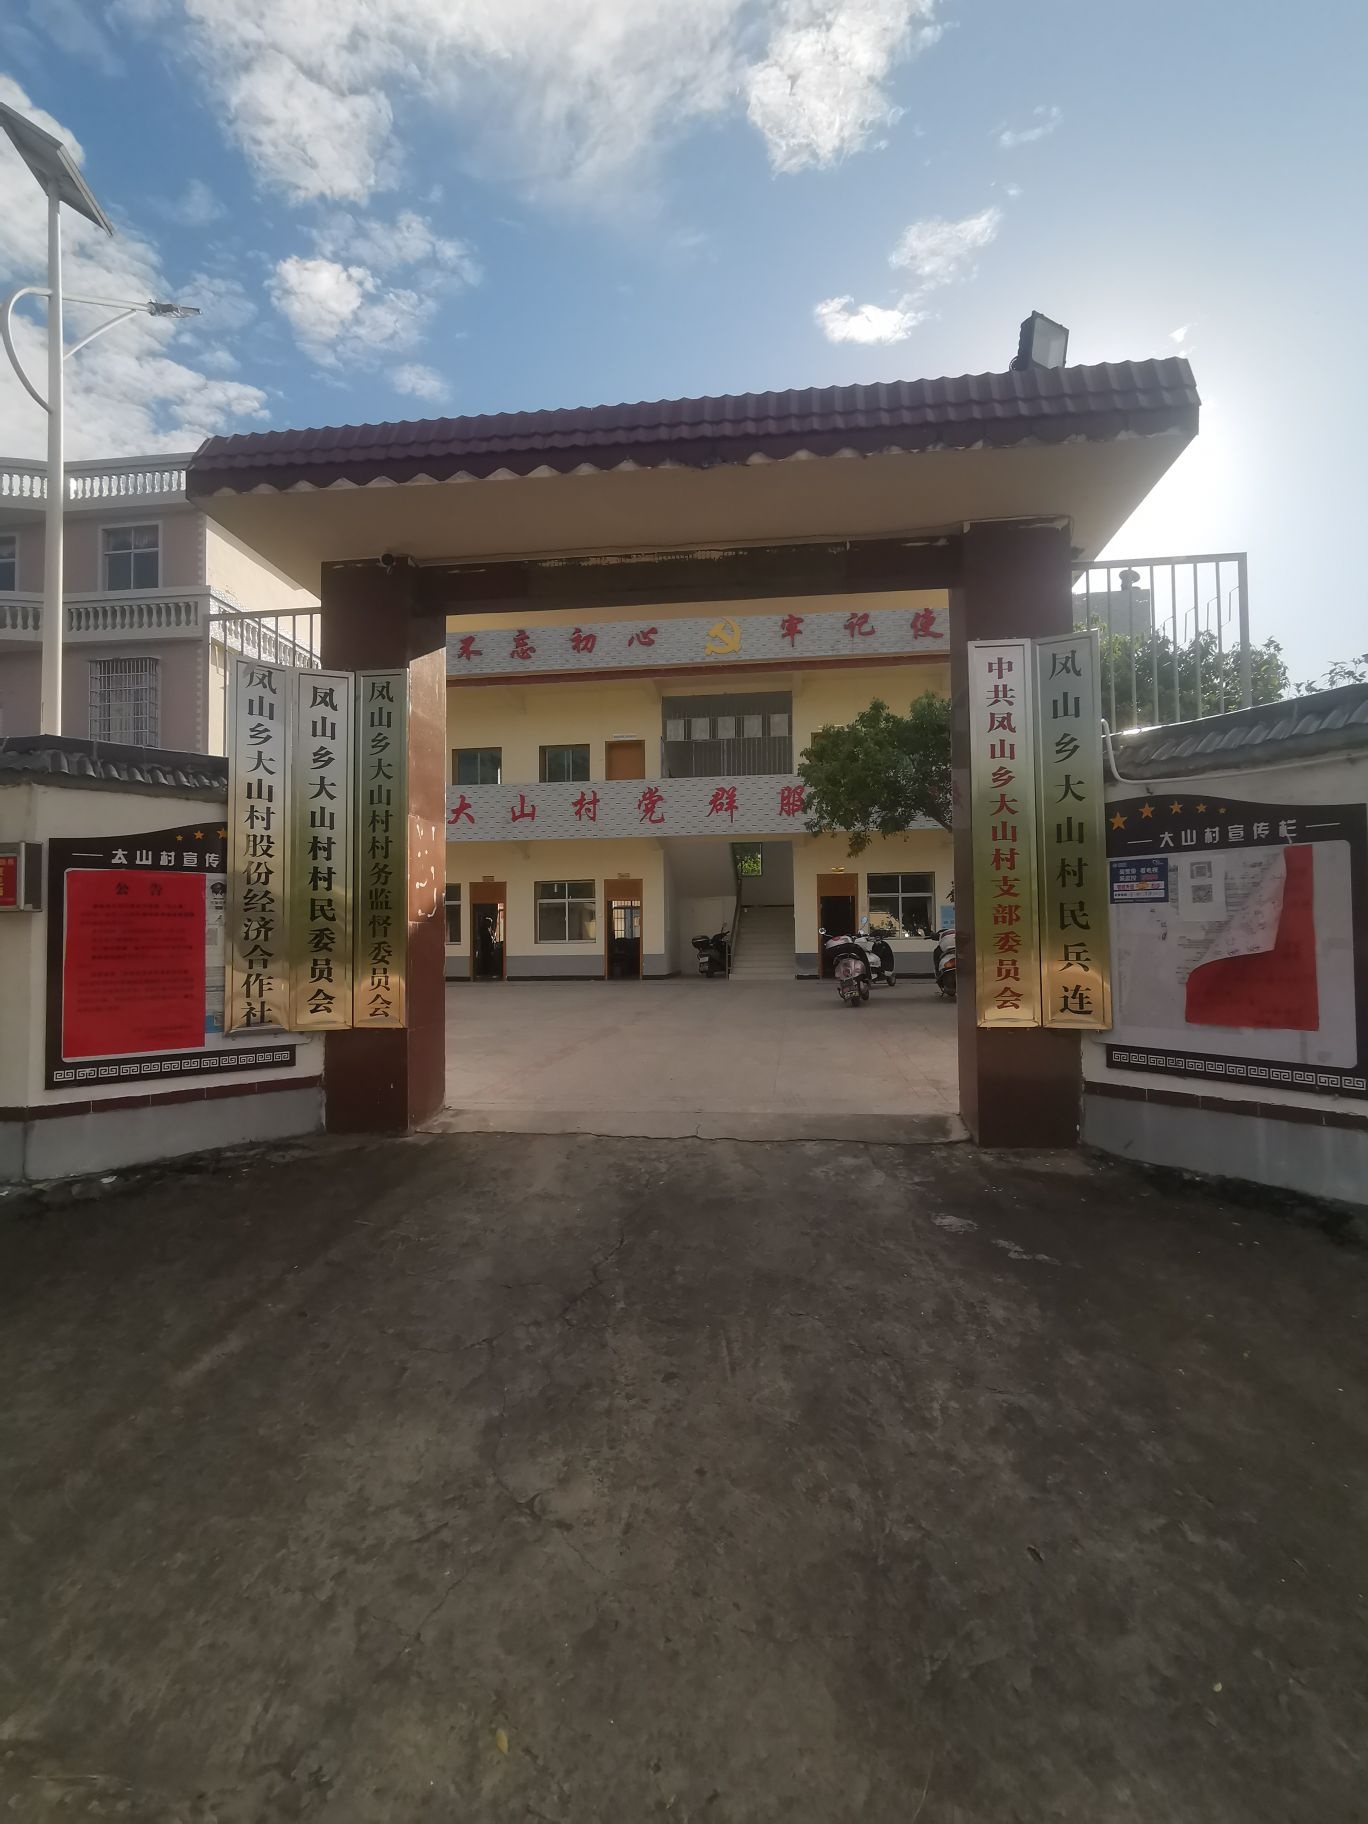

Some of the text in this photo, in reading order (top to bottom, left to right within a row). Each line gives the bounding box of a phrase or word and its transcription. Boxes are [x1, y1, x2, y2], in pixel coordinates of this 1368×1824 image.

[456, 628, 660, 661] 不忘初心
[241, 669, 278, 1027] 凤山乡大山村股份经济合作社
[306, 685, 339, 1015] 凤山乡大山村村民委员会
[367, 681, 394, 1018] 凤山乡大山村村务监督委员会
[986, 656, 1024, 1010] 中共凤山乡大山村支部委员会
[1048, 649, 1094, 1014] 凤山乡大山村民兵连
[1159, 819, 1298, 848] 大山村宣传栏
